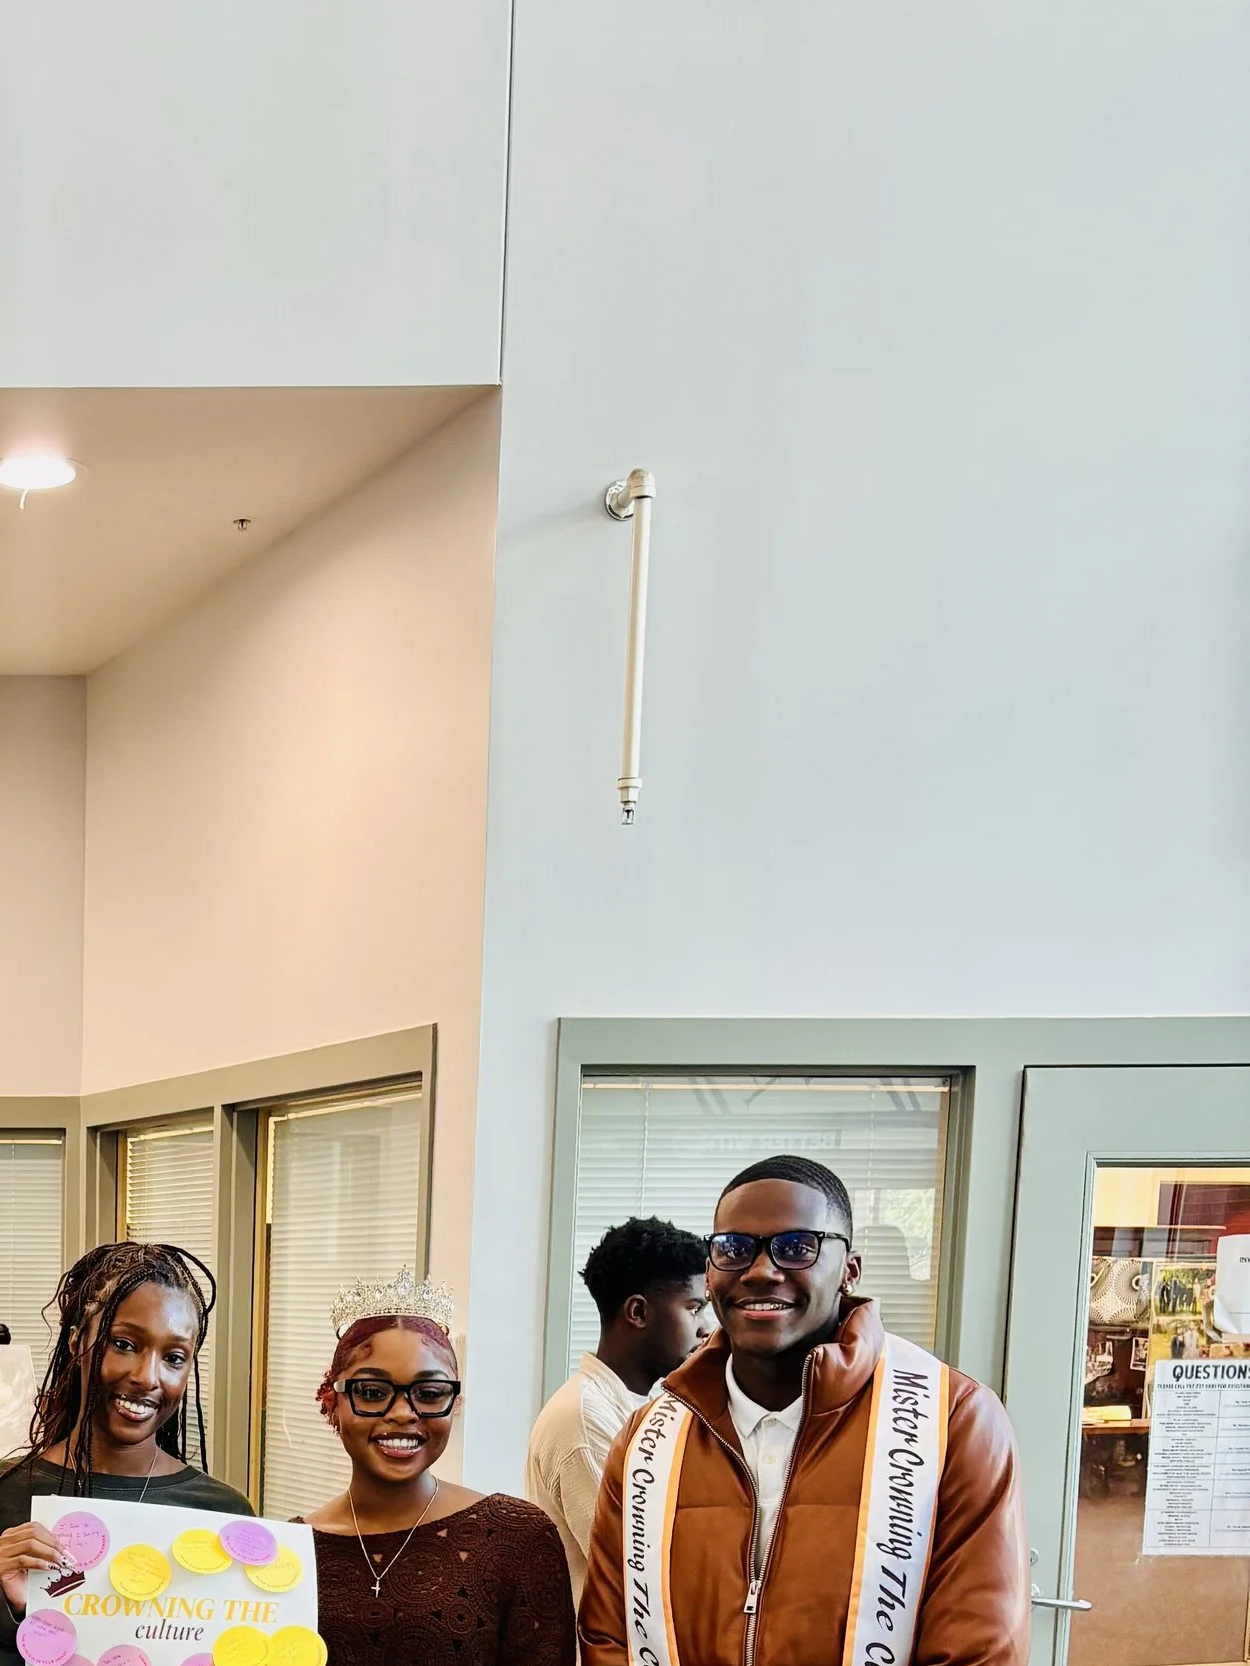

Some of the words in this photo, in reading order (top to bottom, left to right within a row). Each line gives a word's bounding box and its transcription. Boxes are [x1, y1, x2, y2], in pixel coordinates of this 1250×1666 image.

[638, 1391, 678, 1466] Mister
[892, 1368, 930, 1448] Mister
[627, 1468, 655, 1572] Crowning
[876, 1448, 924, 1560] Crowning
[63, 1593, 215, 1621] CROWNING
[223, 1599, 280, 1624] THE
[135, 1618, 204, 1641] culture
[634, 1577, 651, 1640] The
[875, 1565, 907, 1632] The
